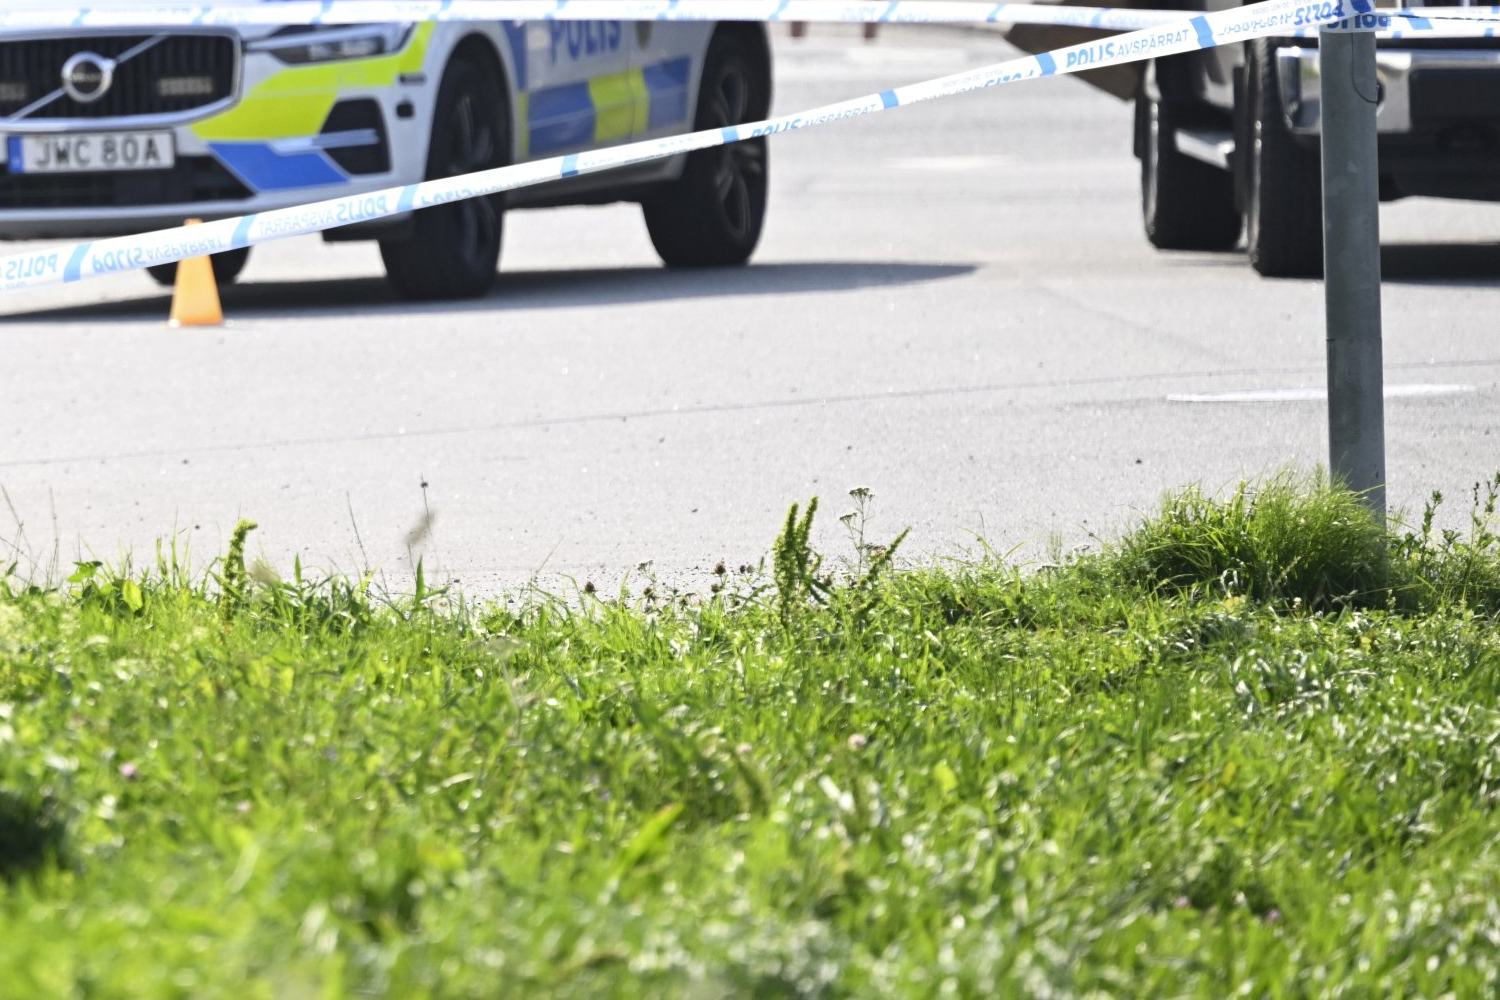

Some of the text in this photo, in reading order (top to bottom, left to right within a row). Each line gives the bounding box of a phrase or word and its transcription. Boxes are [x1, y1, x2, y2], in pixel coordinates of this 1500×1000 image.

[1066, 28, 1189, 68] POLIS AVSPÄRRAT
[35, 131, 161, 167] JWC 80A
